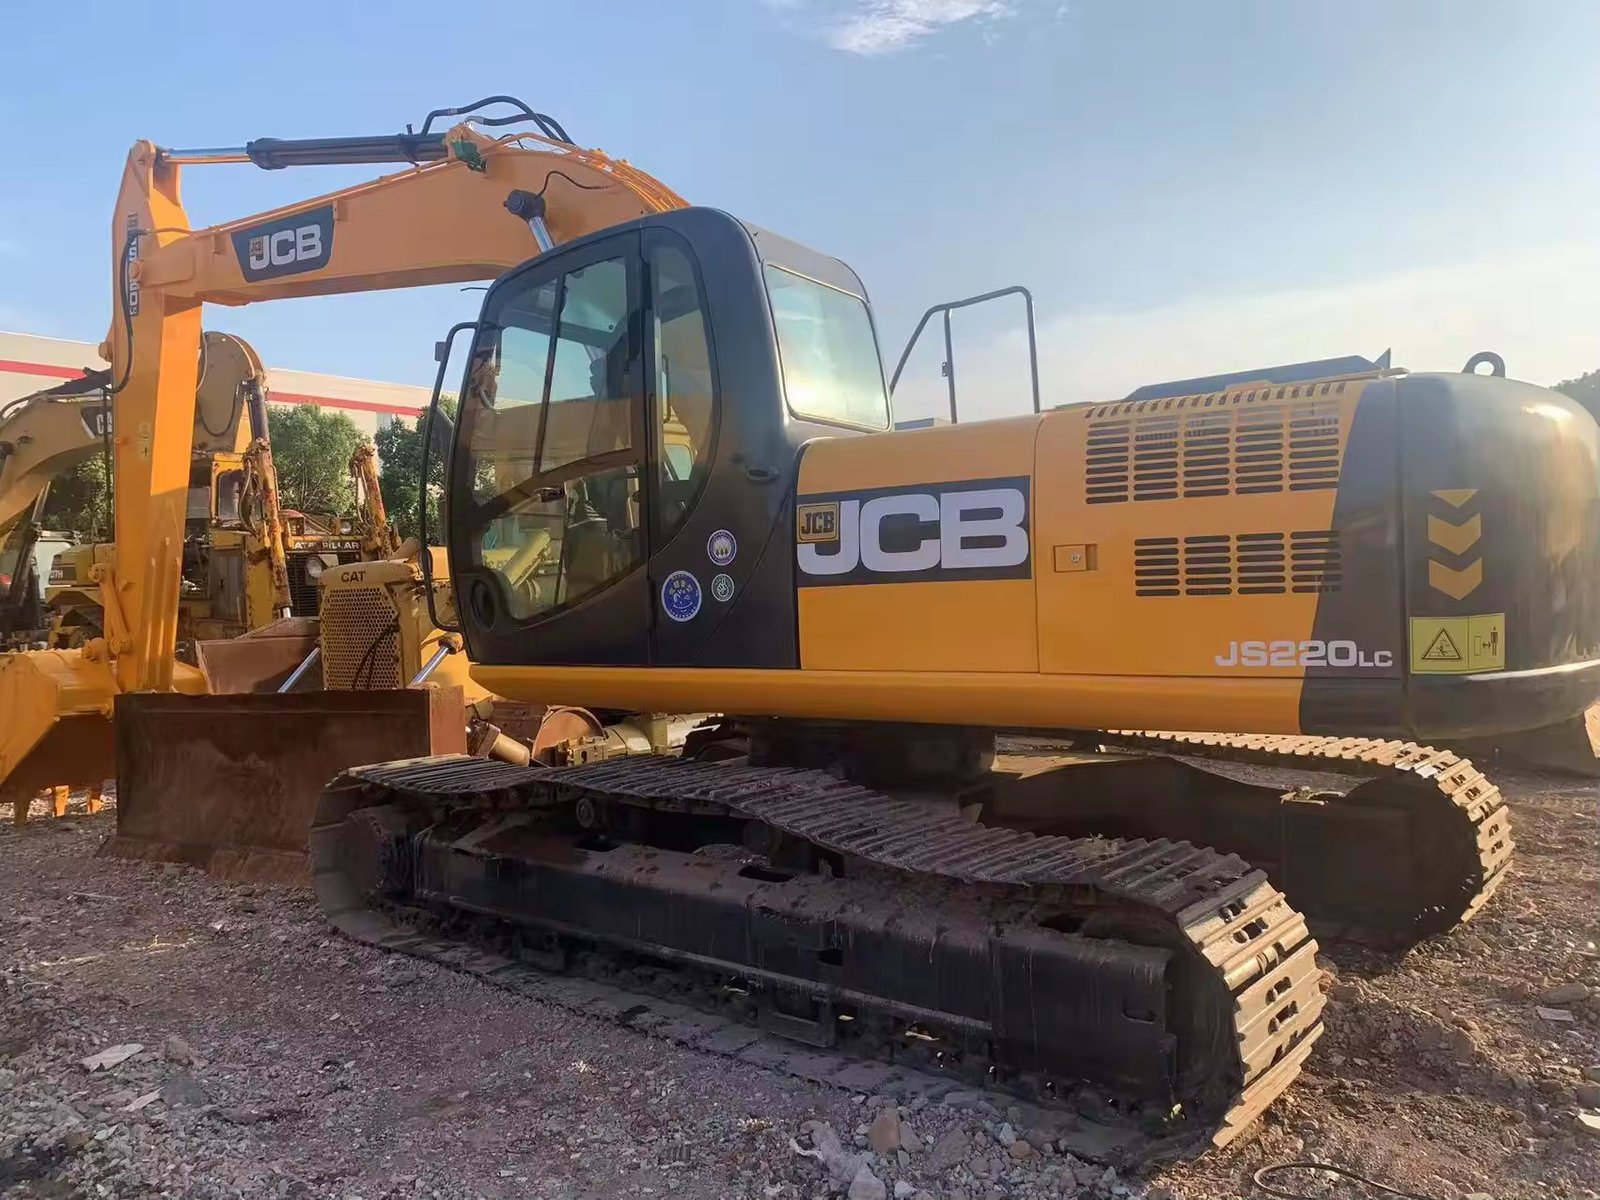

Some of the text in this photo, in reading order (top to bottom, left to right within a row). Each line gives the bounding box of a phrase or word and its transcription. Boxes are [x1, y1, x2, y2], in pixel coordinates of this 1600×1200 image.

[249, 224, 322, 271] JCB
[797, 488, 1030, 575] JCB
[801, 511, 835, 535] JCB
[341, 571, 366, 583] CAT
